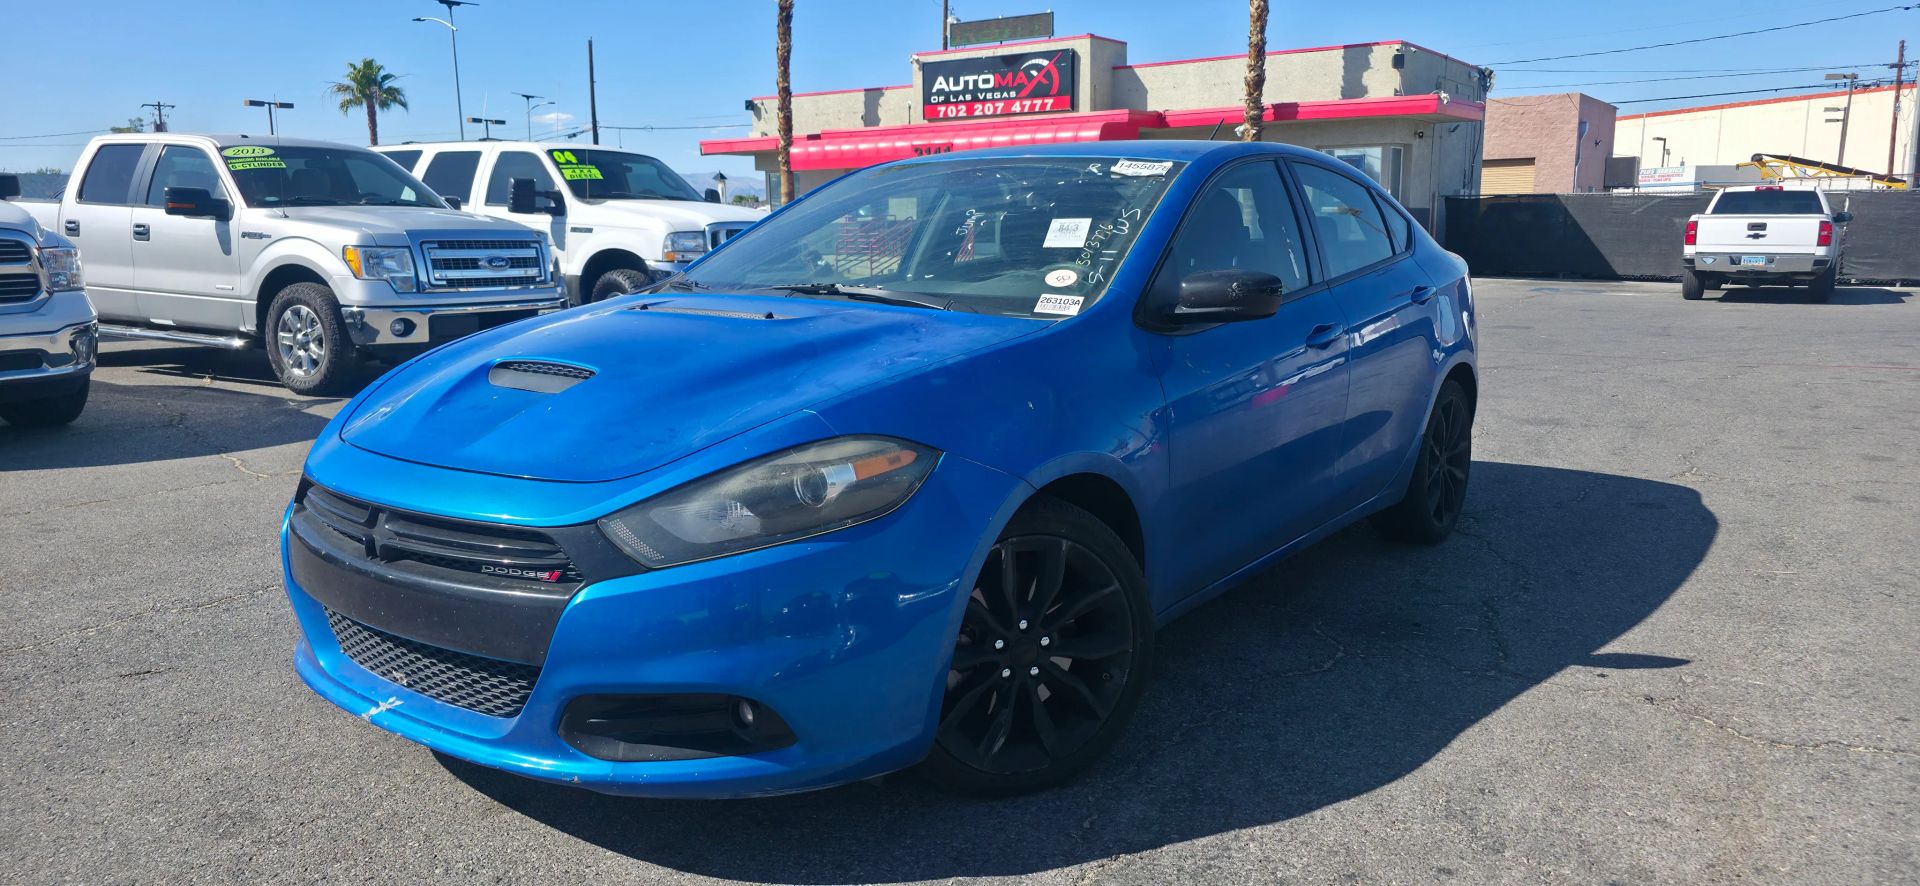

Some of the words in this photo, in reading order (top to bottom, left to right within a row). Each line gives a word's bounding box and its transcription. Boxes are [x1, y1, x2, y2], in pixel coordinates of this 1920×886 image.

[932, 52, 1062, 97] AUTOMAX
[931, 95, 944, 103] OF
[950, 94, 972, 102] LAS
[978, 91, 1016, 100] VEGAS
[937, 106, 967, 118] 702
[974, 103, 1004, 115] 207
[1011, 99, 1054, 113] 4777
[232, 148, 265, 156] 2013
[1040, 296, 1081, 306] 263103A
[481, 565, 550, 580] DODGE
